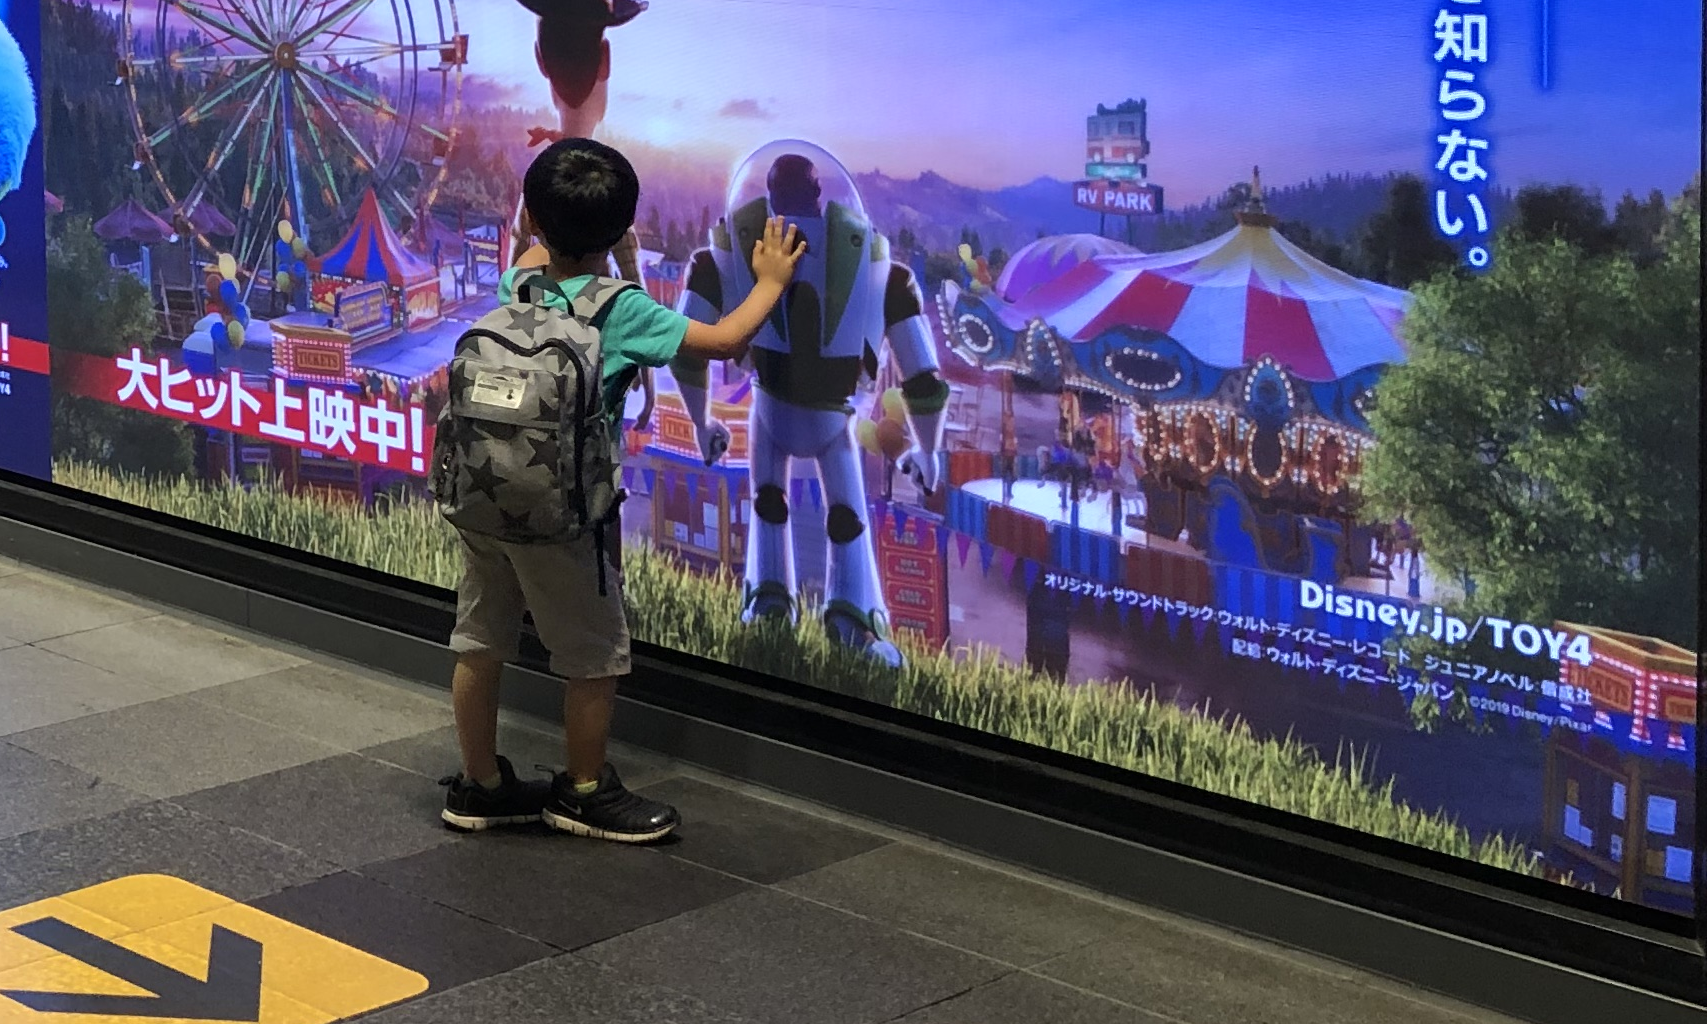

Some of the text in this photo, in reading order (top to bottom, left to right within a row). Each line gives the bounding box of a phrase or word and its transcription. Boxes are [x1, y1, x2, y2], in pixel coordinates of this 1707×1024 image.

[1077, 187, 1153, 212] RV PARK
[116, 347, 425, 473] 大ヒット上映中!
[1299, 579, 1592, 667] Disney.jp/TOY4
